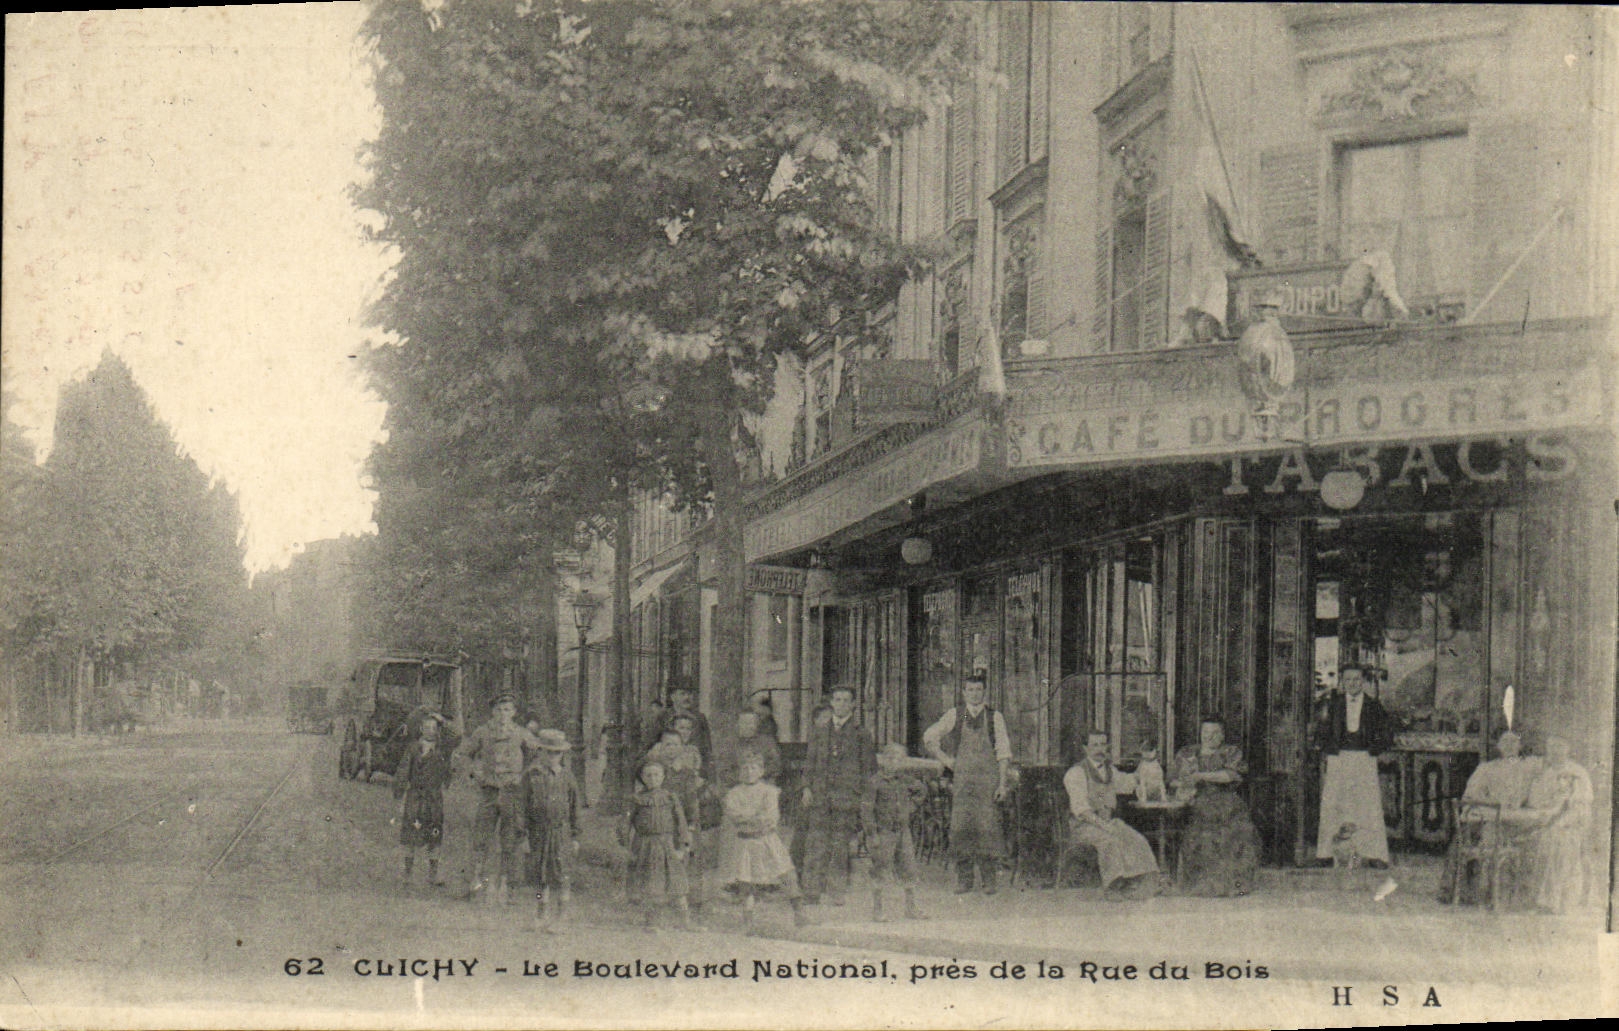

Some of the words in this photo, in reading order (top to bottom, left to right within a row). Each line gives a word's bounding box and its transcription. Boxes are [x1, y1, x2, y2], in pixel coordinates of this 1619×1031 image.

[1038, 407, 1160, 455] CAFÉ
[1188, 411, 1245, 444] DU
[1222, 430, 1577, 495] TABACS
